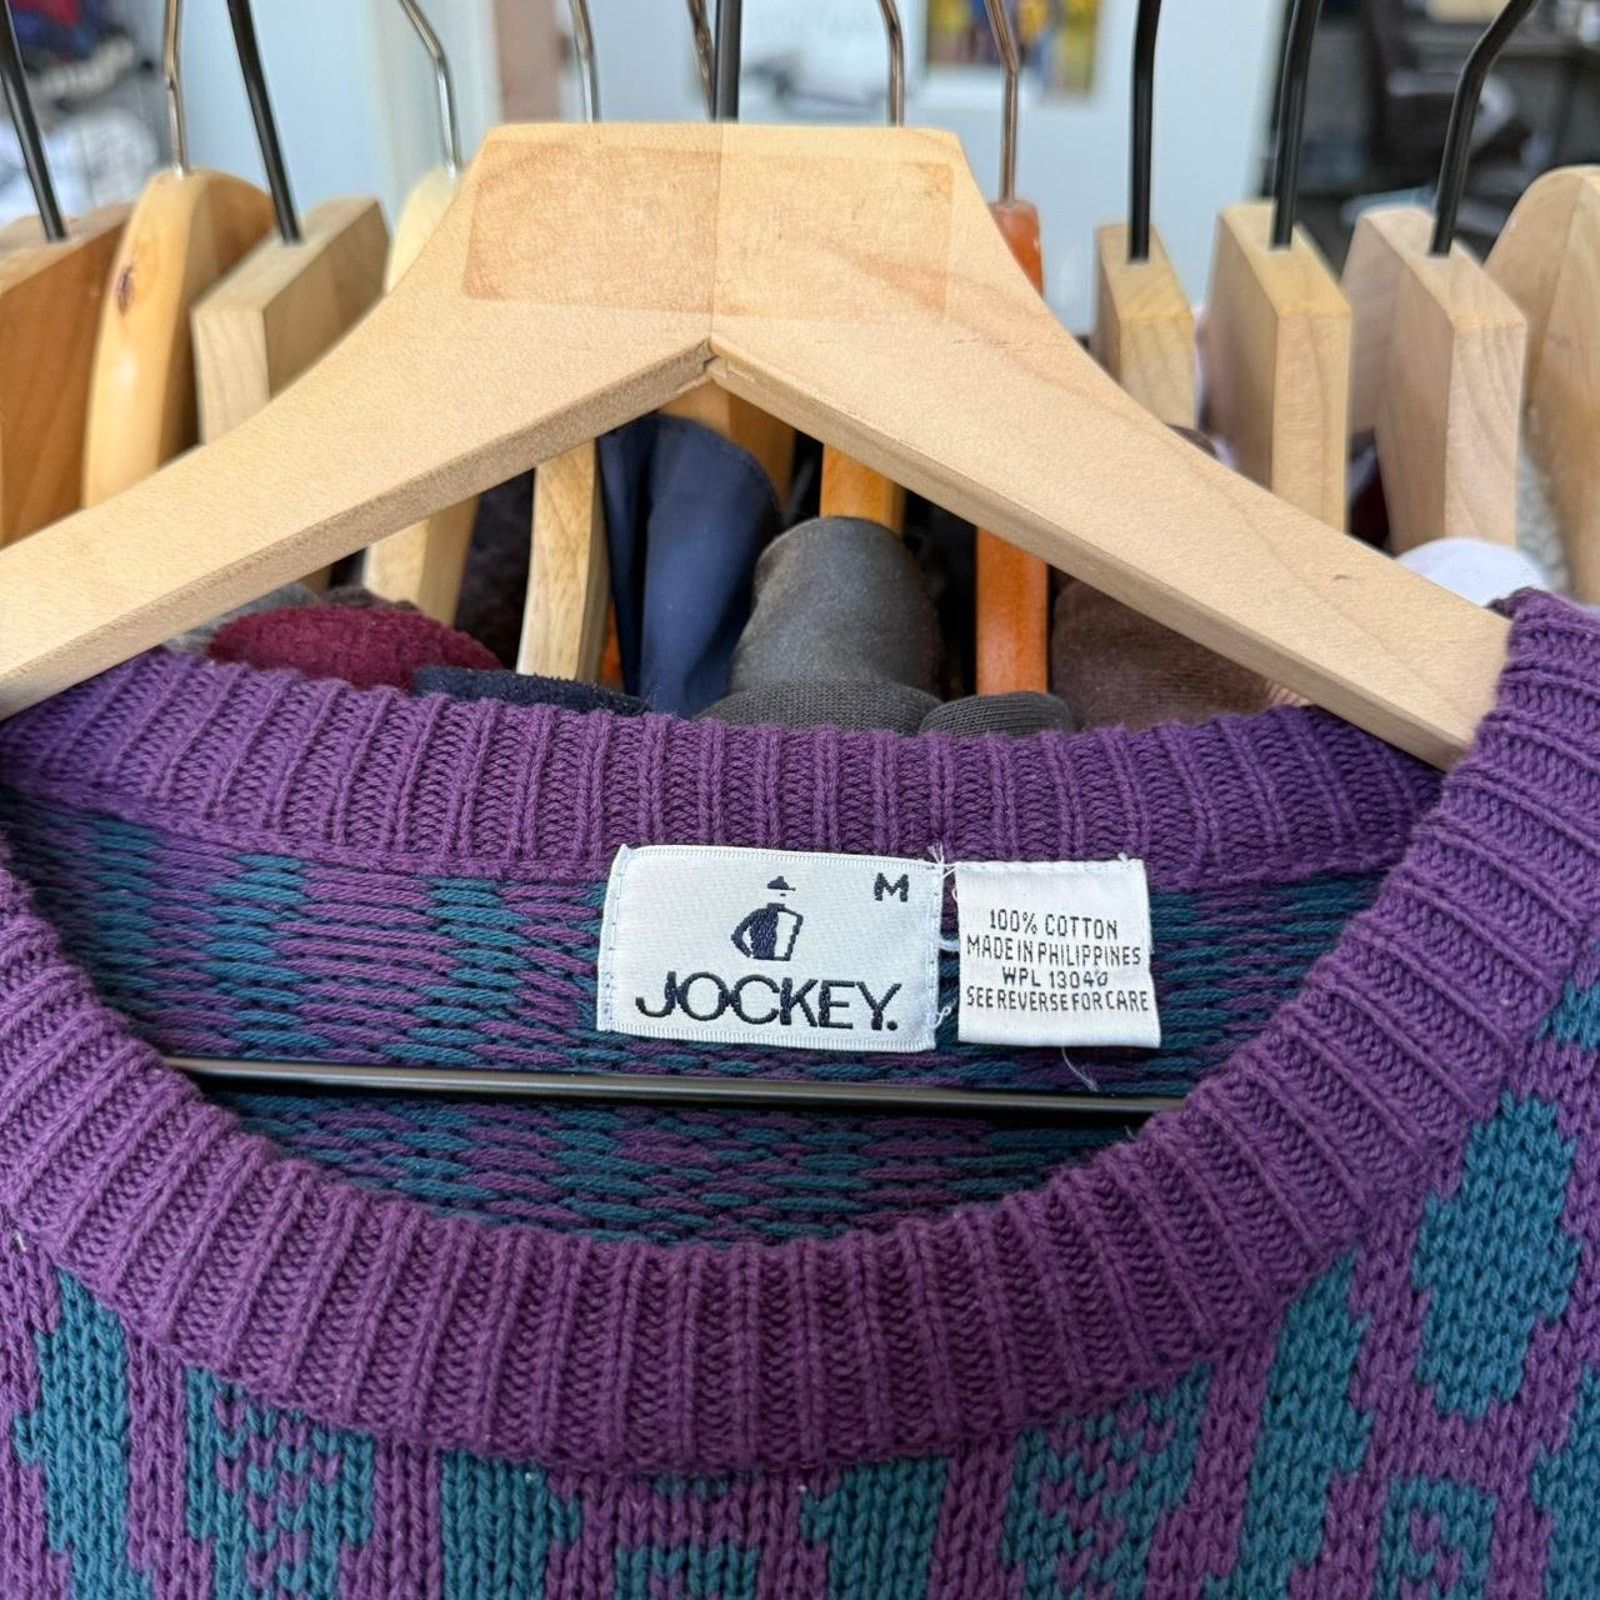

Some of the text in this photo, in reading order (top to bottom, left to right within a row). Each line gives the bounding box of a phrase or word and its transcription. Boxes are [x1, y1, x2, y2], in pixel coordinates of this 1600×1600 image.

[873, 872, 910, 903] M
[989, 908, 1118, 940] 100% COTTON
[966, 933, 1142, 967] MADE IN PHILIPPINES
[1001, 966, 1041, 987] WPL
[635, 970, 903, 1031] JOCKEY.
[966, 985, 1149, 1013] SEE REVERSE FOR CARE
